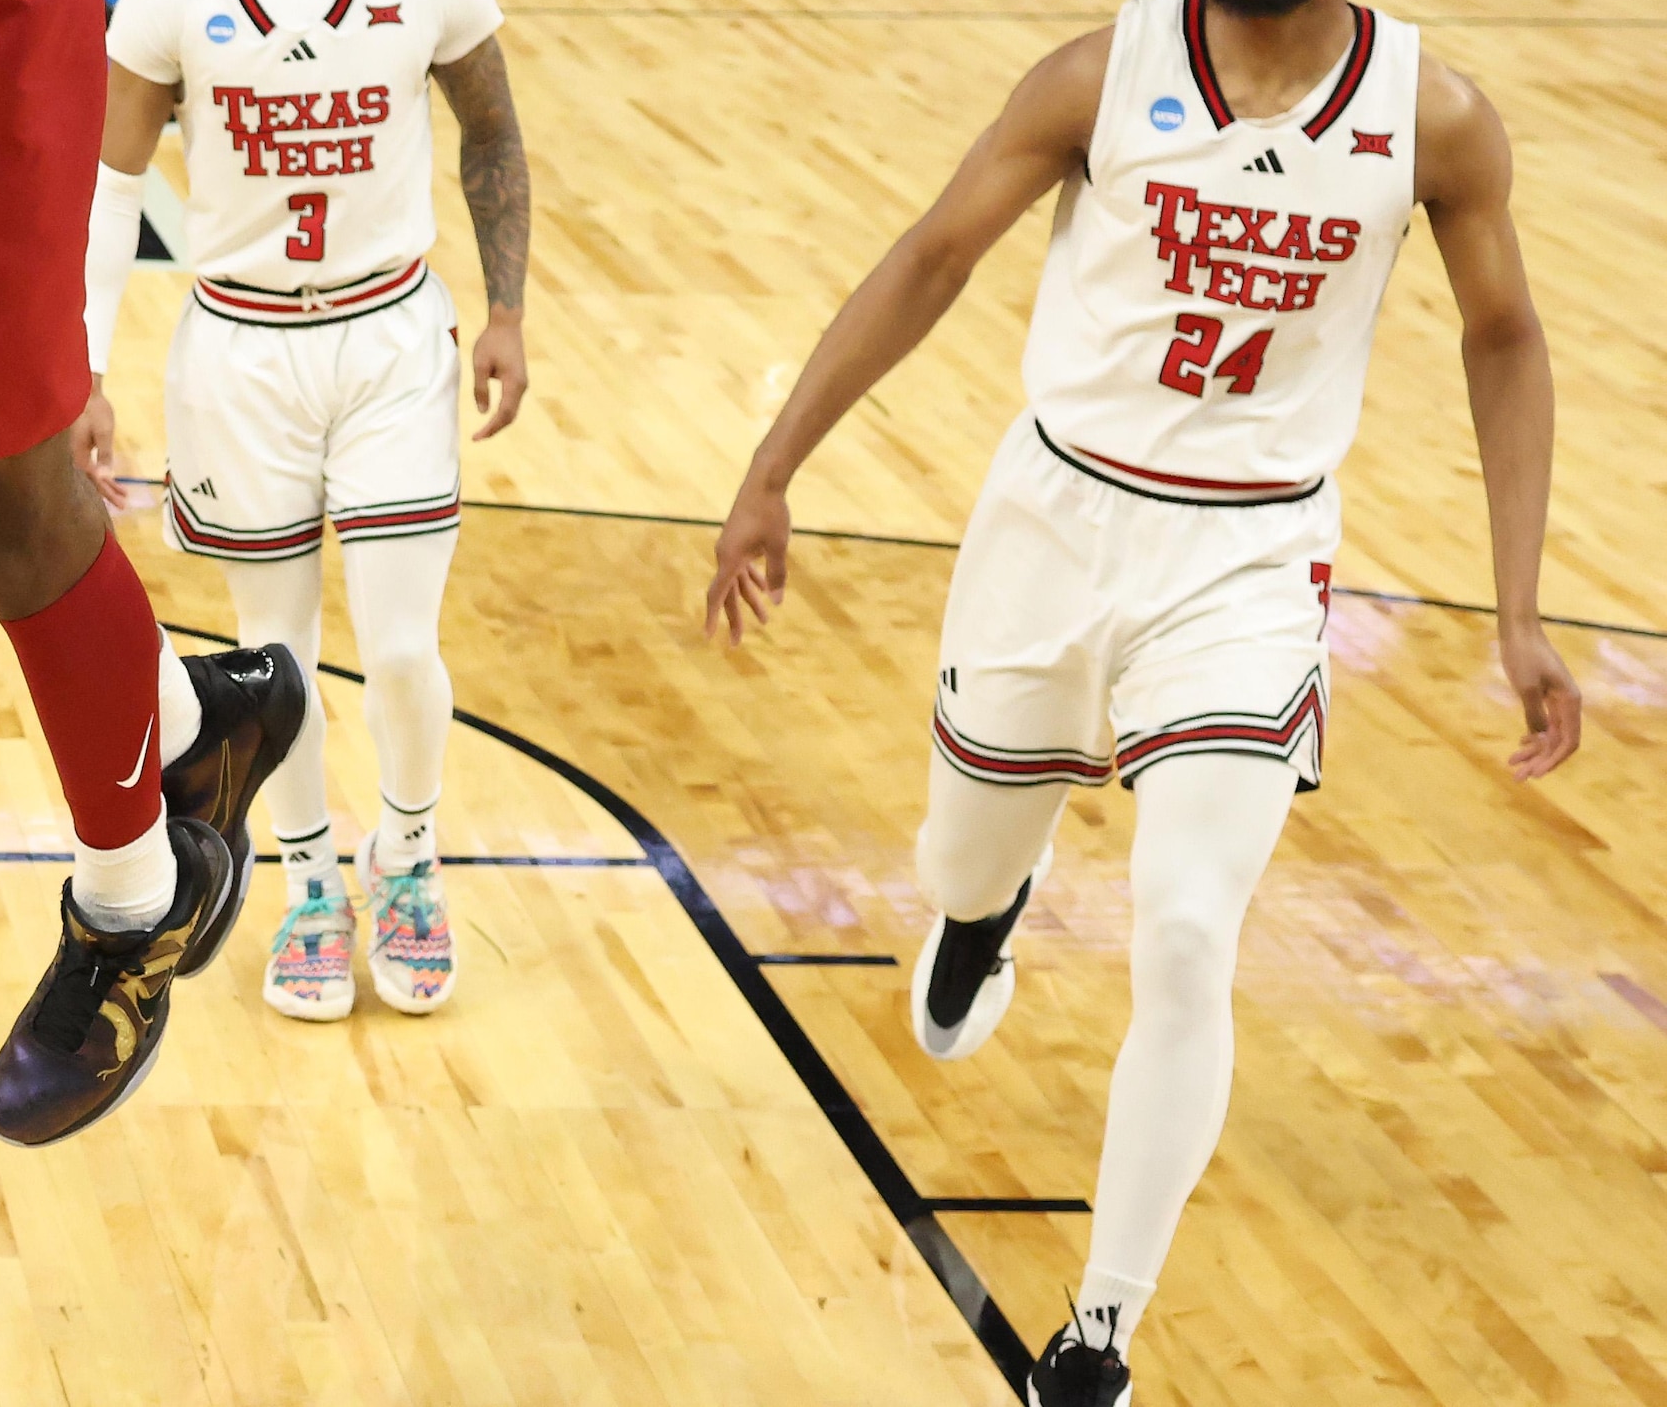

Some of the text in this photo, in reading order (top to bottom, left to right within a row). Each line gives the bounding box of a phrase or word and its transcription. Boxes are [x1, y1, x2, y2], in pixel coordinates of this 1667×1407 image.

[213, 85, 391, 133] TEXAS
[233, 131, 375, 177] TECH
[285, 192, 328, 262] 3
[1145, 181, 1361, 262] TEXAS
[1157, 238, 1327, 312] TECH
[1158, 313, 1275, 398] 24
